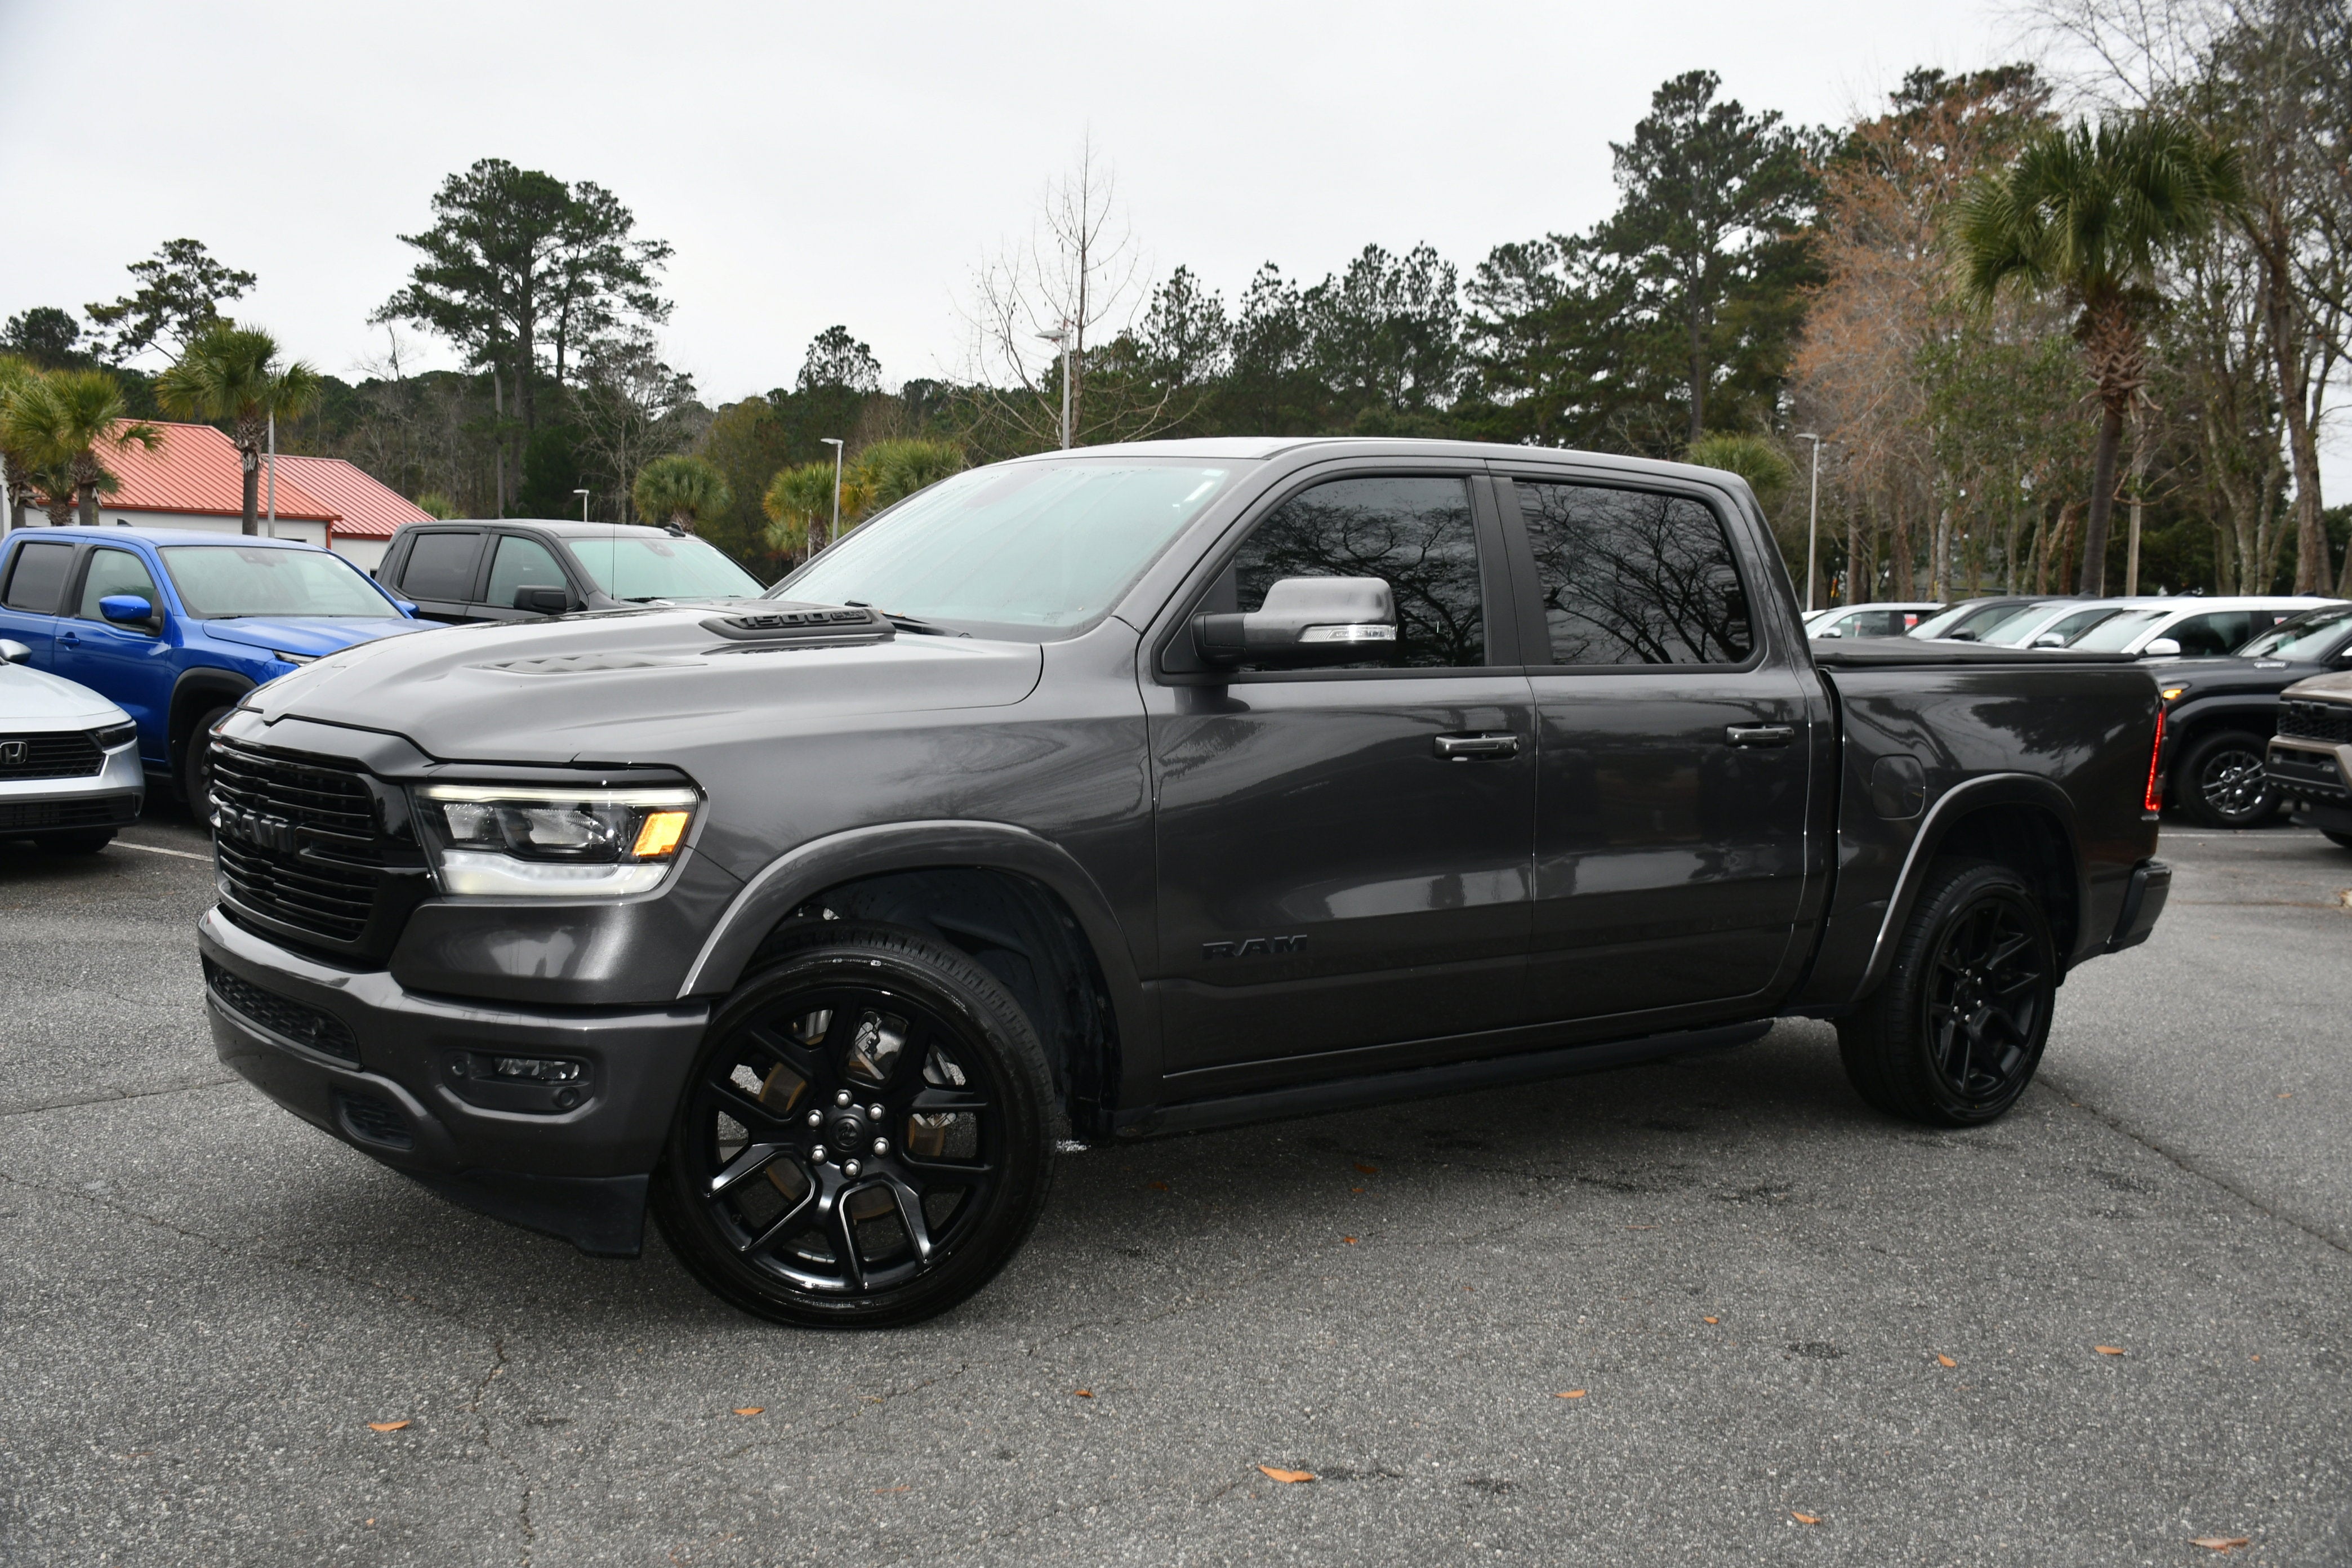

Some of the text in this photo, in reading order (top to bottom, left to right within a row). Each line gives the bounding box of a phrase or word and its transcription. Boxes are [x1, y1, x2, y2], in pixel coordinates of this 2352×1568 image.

[740, 612, 831, 627] 1500
[221, 806, 290, 854] RAM
[1201, 934, 1307, 960] RAM
